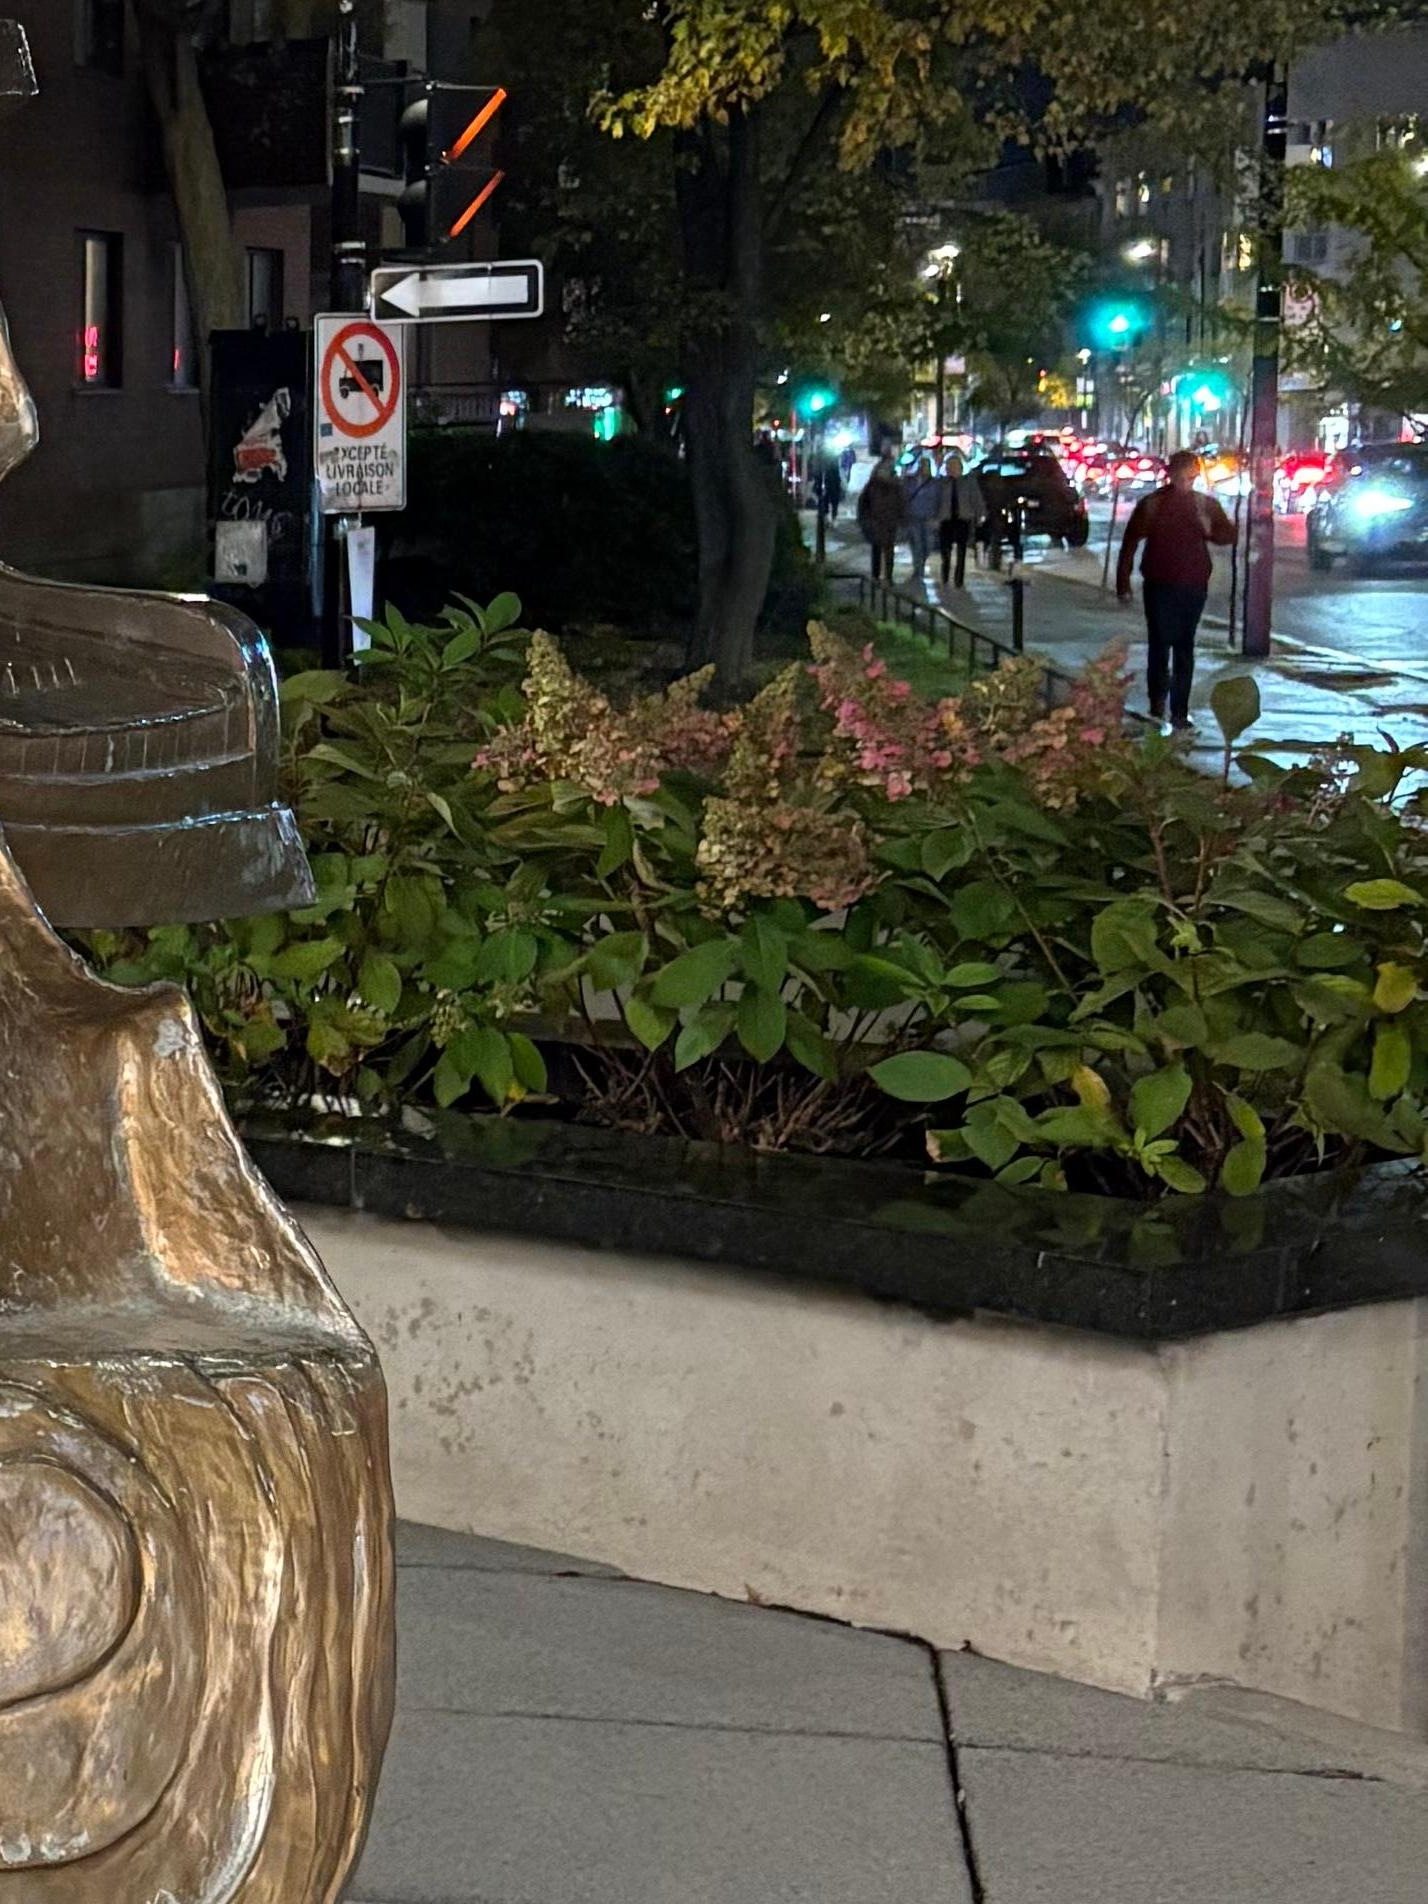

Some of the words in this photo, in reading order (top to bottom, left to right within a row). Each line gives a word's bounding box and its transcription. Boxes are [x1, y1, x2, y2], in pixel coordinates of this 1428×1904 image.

[333, 443, 387, 461] XCEPTÉ
[326, 463, 393, 479] LIVRAISON
[335, 480, 383, 496] LOCALE
